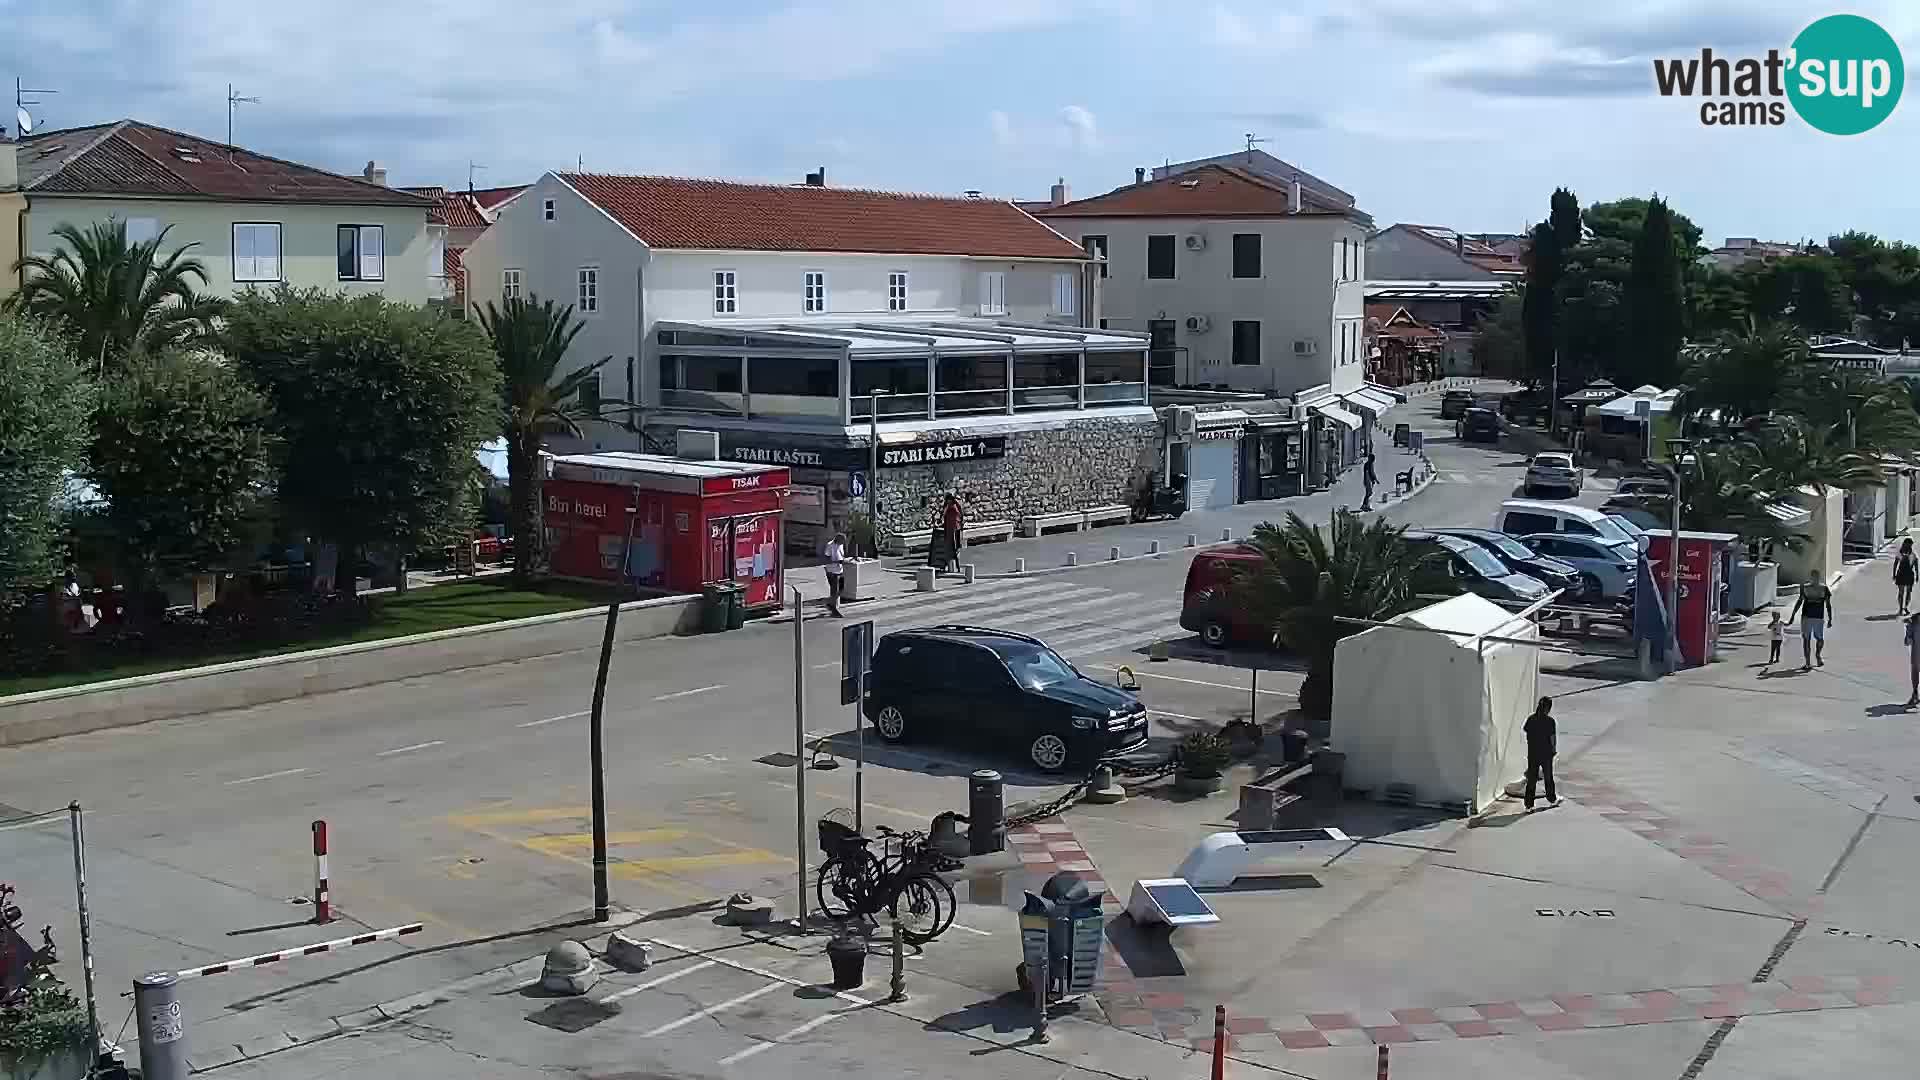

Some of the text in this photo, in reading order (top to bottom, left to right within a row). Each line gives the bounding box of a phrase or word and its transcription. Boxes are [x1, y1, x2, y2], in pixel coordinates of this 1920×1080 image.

[1199, 430, 1236, 440] MARKET
[735, 447, 823, 466] STARI KAŠTEL
[883, 443, 975, 465] STARI KAŠTEL
[731, 475, 760, 489] TISAK
[575, 497, 607, 518] here!
